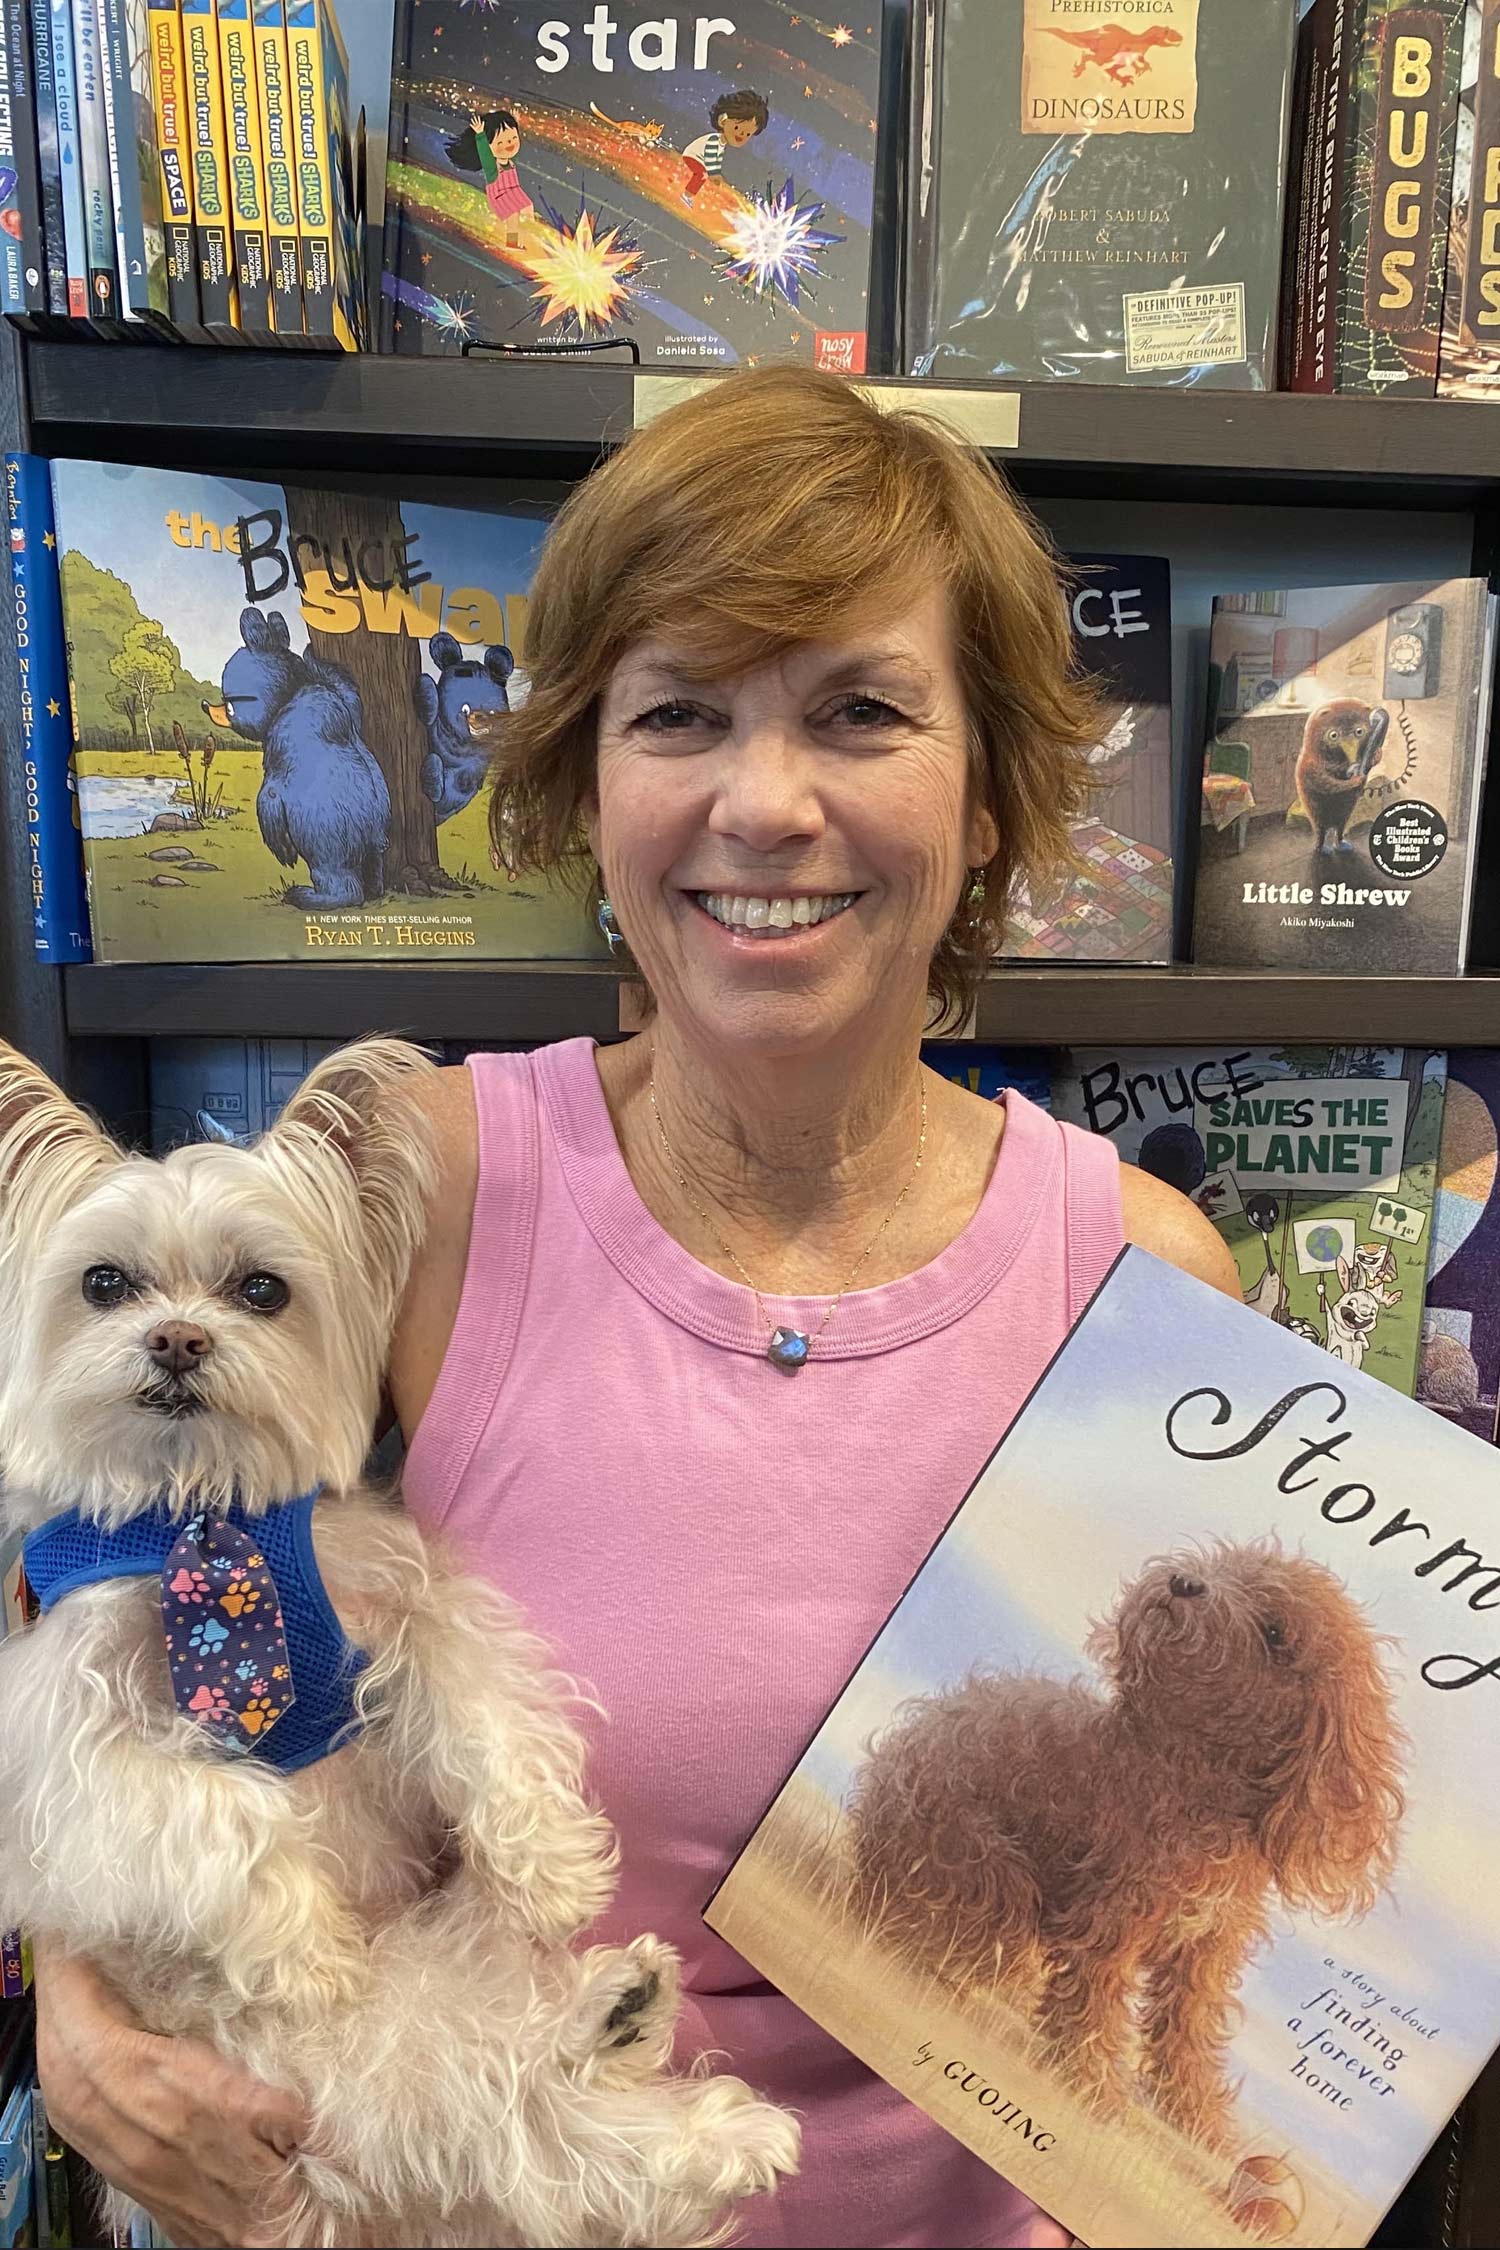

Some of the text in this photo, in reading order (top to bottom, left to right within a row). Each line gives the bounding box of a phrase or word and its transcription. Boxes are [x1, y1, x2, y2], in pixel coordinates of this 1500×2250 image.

[10, 3, 25, 97] The Ocean at Night
[54, 35, 65, 61] see
[82, 28, 94, 46] be
[535, 5, 737, 73] star
[1331, 0, 1344, 72] MEET
[57, 69, 68, 78] a
[83, 53, 96, 101] eaten
[58, 85, 72, 132] cloud
[157, 25, 186, 209] weird but true! SPACE
[191, 27, 222, 215] weird but true! SHARKS
[1031, 98, 1185, 120] DINOSAURS
[1326, 75, 1340, 135] THE
[228, 32, 260, 220] weird but true! SHARKS
[263, 39, 294, 226] weird but true! SHARKS
[296, 41, 325, 227] weird but true! SHARKS
[1378, 36, 1432, 309] BUGS
[93, 190, 103, 225] rocky
[1105, 209, 1170, 222] SABUDA
[1095, 228, 1111, 244] &
[6, 246, 19, 300] LAURA BAKER
[175, 240, 184, 282] GEOGRAPHIC
[209, 243, 218, 284] GEOGRAPHIC
[216, 243, 224, 276] NATIONAL
[247, 247, 256, 288] GEOGRAPHIC
[254, 248, 262, 280] NATIONAL
[282, 252, 291, 294] GEOGRAPHIC
[288, 253, 296, 286] NATIONAL
[319, 254, 327, 286] NATIONAL
[1105, 250, 1190, 263] REINHART
[1318, 227, 1330, 283] EYE
[313, 253, 321, 295] GEOGRAPHIC
[1131, 314, 1161, 322] FEATURES
[1137, 291, 1236, 312] DEFINITIVE POP-UP!
[1317, 286, 1327, 323] TO
[537, 336, 578, 344] written by
[656, 346, 726, 356] Daniela Sosa
[665, 335, 718, 345] illustrated by
[821, 336, 855, 355] nosy
[1132, 352, 1174, 365] SABUDA
[1186, 346, 1238, 359] REINHART
[1314, 328, 1325, 382] EYE
[165, 510, 253, 555] the
[14, 584, 44, 910] GOOD NIGHT, GOOD NIGHT
[1385, 826, 1432, 836] Illustrated
[1386, 835, 1430, 845] Children's
[1399, 817, 1419, 827] Best
[1392, 852, 1421, 862] Award
[1394, 844, 1421, 853] Books
[1242, 882, 1411, 906] Little Shrew
[320, 915, 338, 924] NEW
[341, 915, 362, 924] YORK
[364, 915, 386, 924] TIMES
[388, 915, 440, 924] BEST-SELLING
[442, 915, 473, 925] AUTHOR
[366, 926, 391, 946] T.
[1279, 916, 1355, 929] Akiko Miyakoshi
[1209, 1098, 1389, 1128] SAVES THE
[1206, 1131, 1393, 1175] PLANET
[1166, 1382, 1500, 1690] Storm
[1323, 1957, 1441, 2040] a story about
[1300, 1988, 1409, 2071] finding
[1287, 2017, 1396, 2097] a forever
[912, 2040, 1057, 2152] by GUOJING
[1289, 2054, 1353, 2111] home
